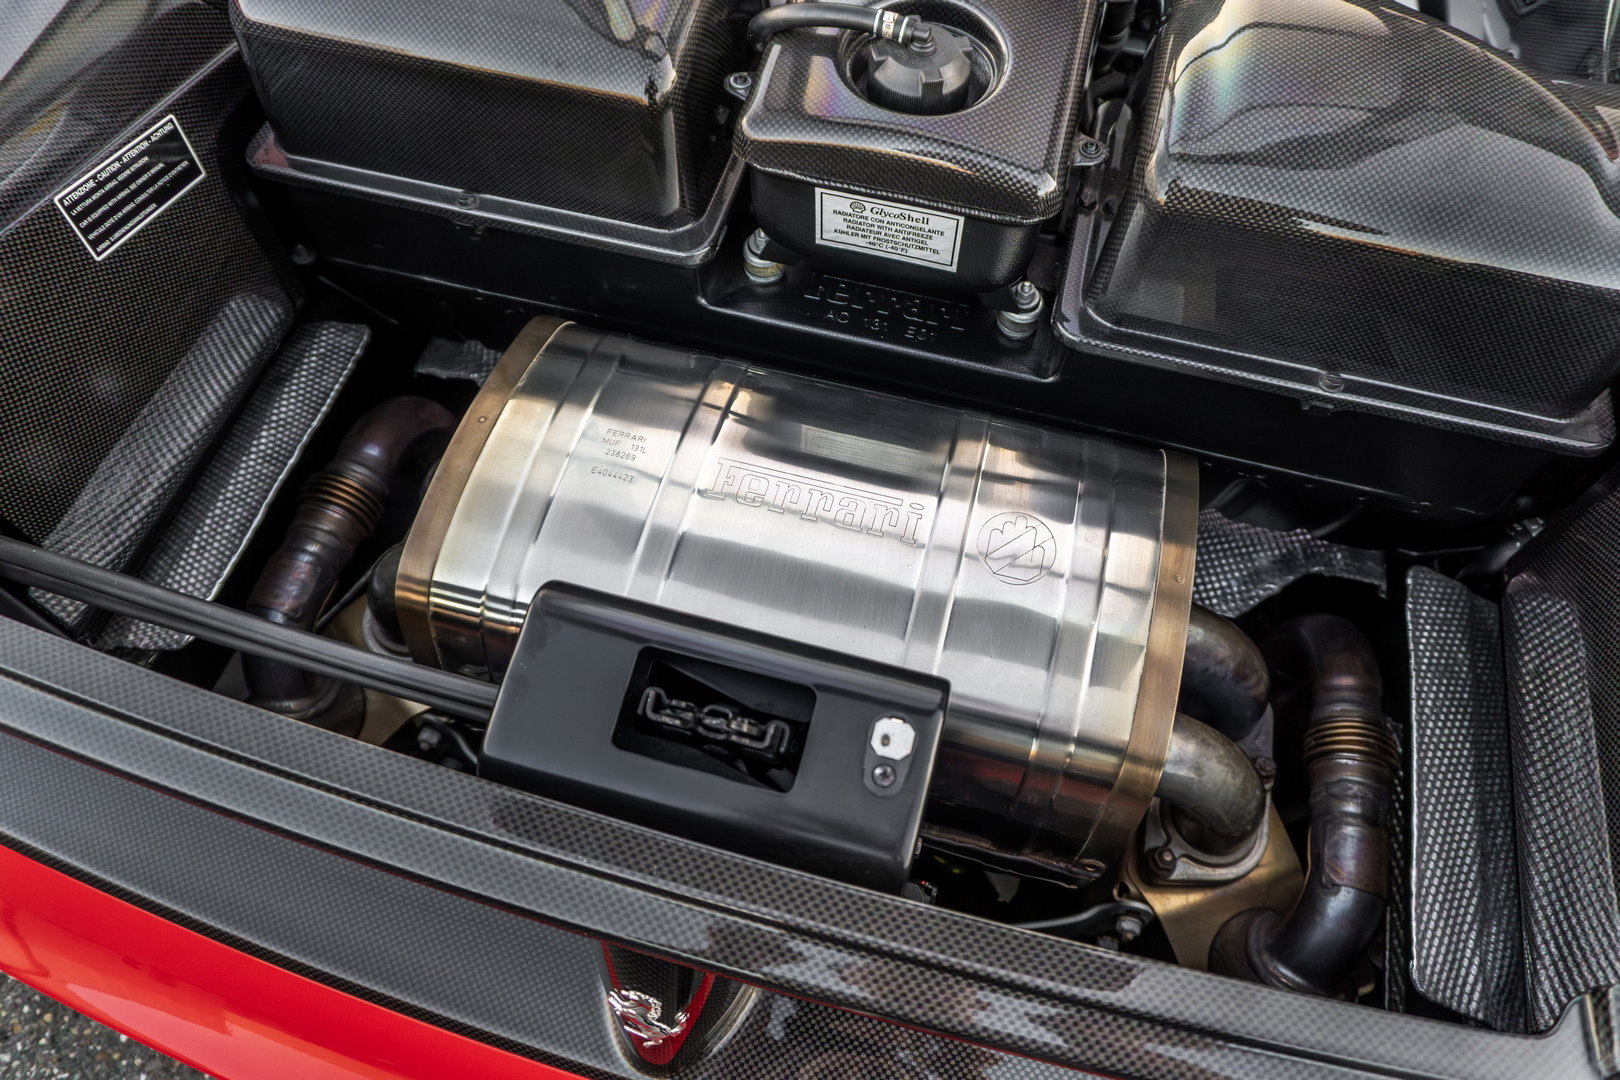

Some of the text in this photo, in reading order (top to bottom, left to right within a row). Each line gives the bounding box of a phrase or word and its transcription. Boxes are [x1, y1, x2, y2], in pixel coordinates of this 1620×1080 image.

[63, 179, 96, 206] ATTENZIONE
[97, 161, 121, 180] CAUTION
[122, 140, 149, 163] ATTENTION
[151, 122, 173, 142] ACHTUNG
[71, 208, 78, 216] LA
[870, 206, 929, 225] GlycoShell
[79, 220, 88, 228] CAR
[832, 209, 945, 237] RADIATORE CON ANTICONGELANTE
[843, 217, 875, 229] RADIATOR
[894, 227, 933, 240] ANTIFREEZE
[833, 228, 860, 238] KÜHLER
[873, 235, 941, 255] FROSTSCHUTZMITTEL
[846, 224, 929, 246] RADIATEUR AVEC ANTIGEL
[606, 428, 647, 443] FERRARI
[631, 444, 647, 454] 131L
[590, 466, 634, 483] E4044423
[703, 457, 925, 546] Ferrari
